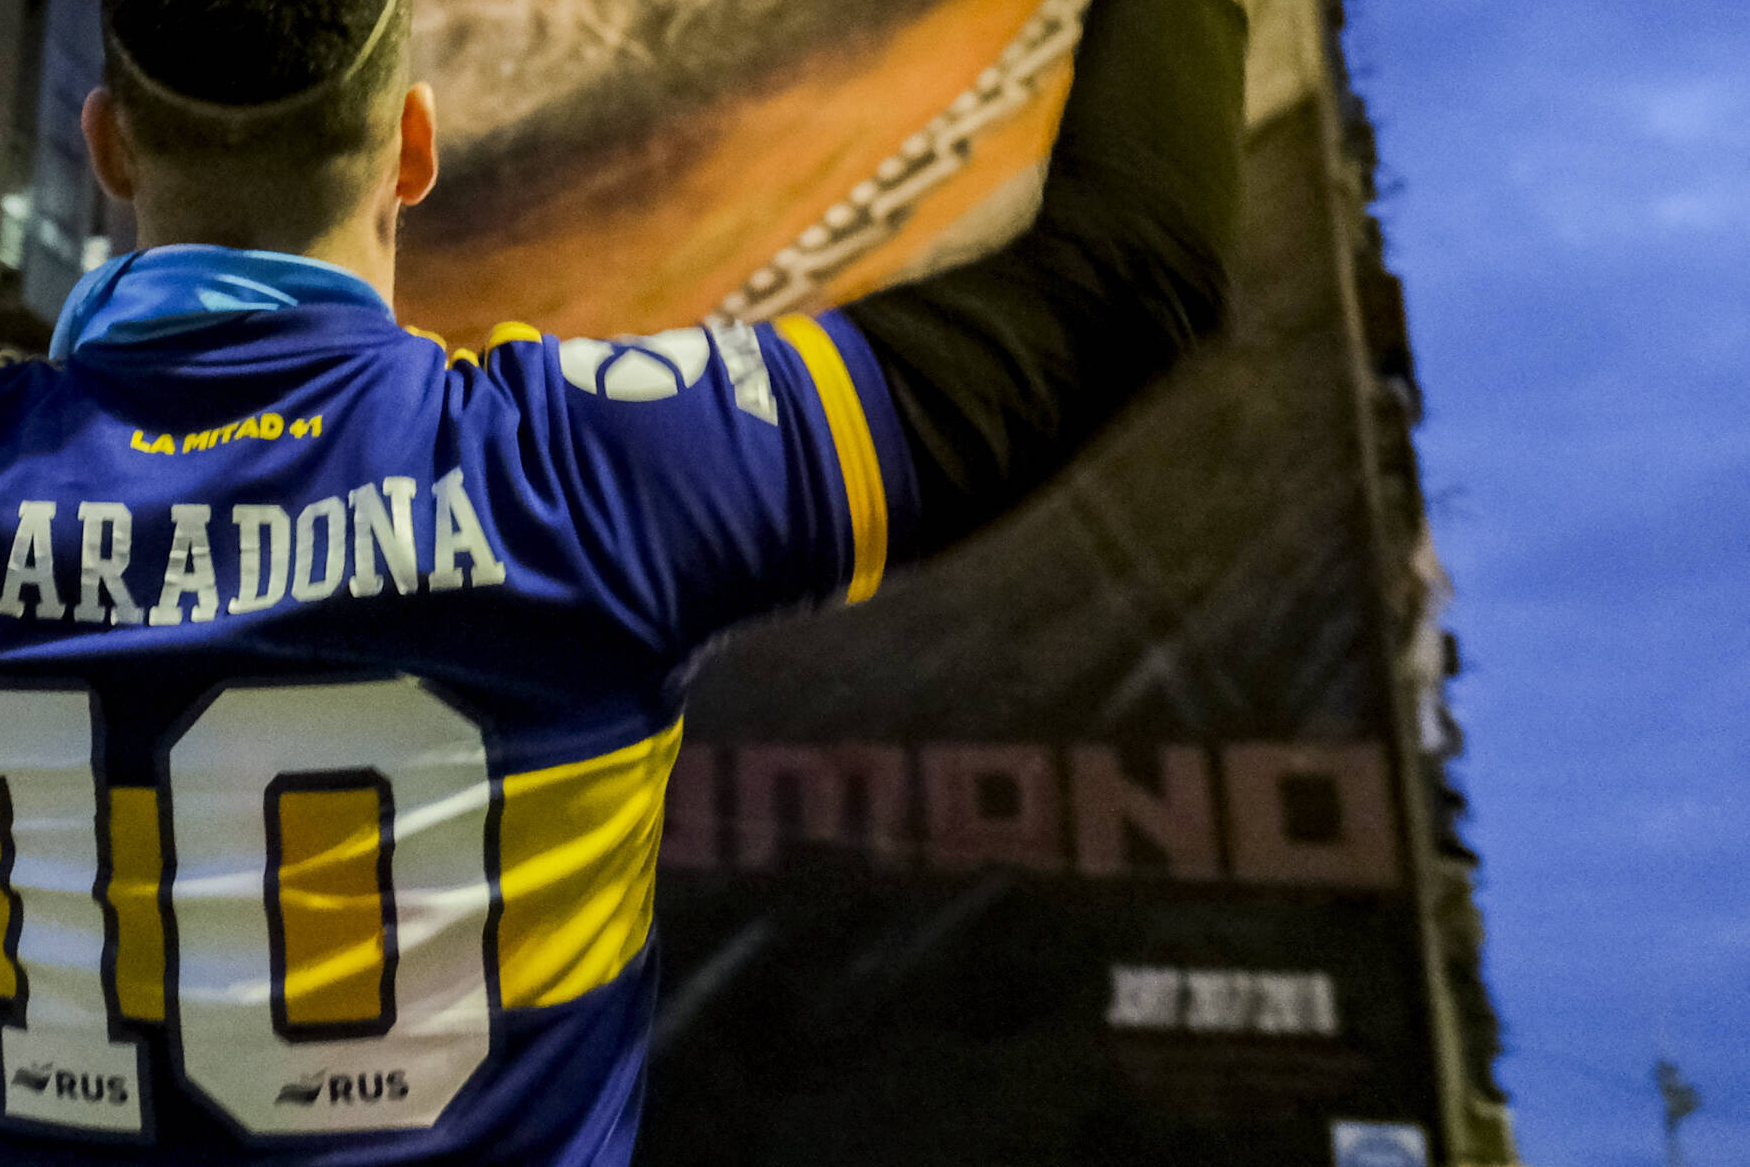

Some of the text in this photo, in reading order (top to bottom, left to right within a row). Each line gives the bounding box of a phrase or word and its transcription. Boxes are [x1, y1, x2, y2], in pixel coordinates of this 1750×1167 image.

[130, 429, 176, 455] LA
[182, 412, 285, 454] MITAD
[54, 1069, 129, 1105] RUS
[328, 1068, 410, 1106] RUS
